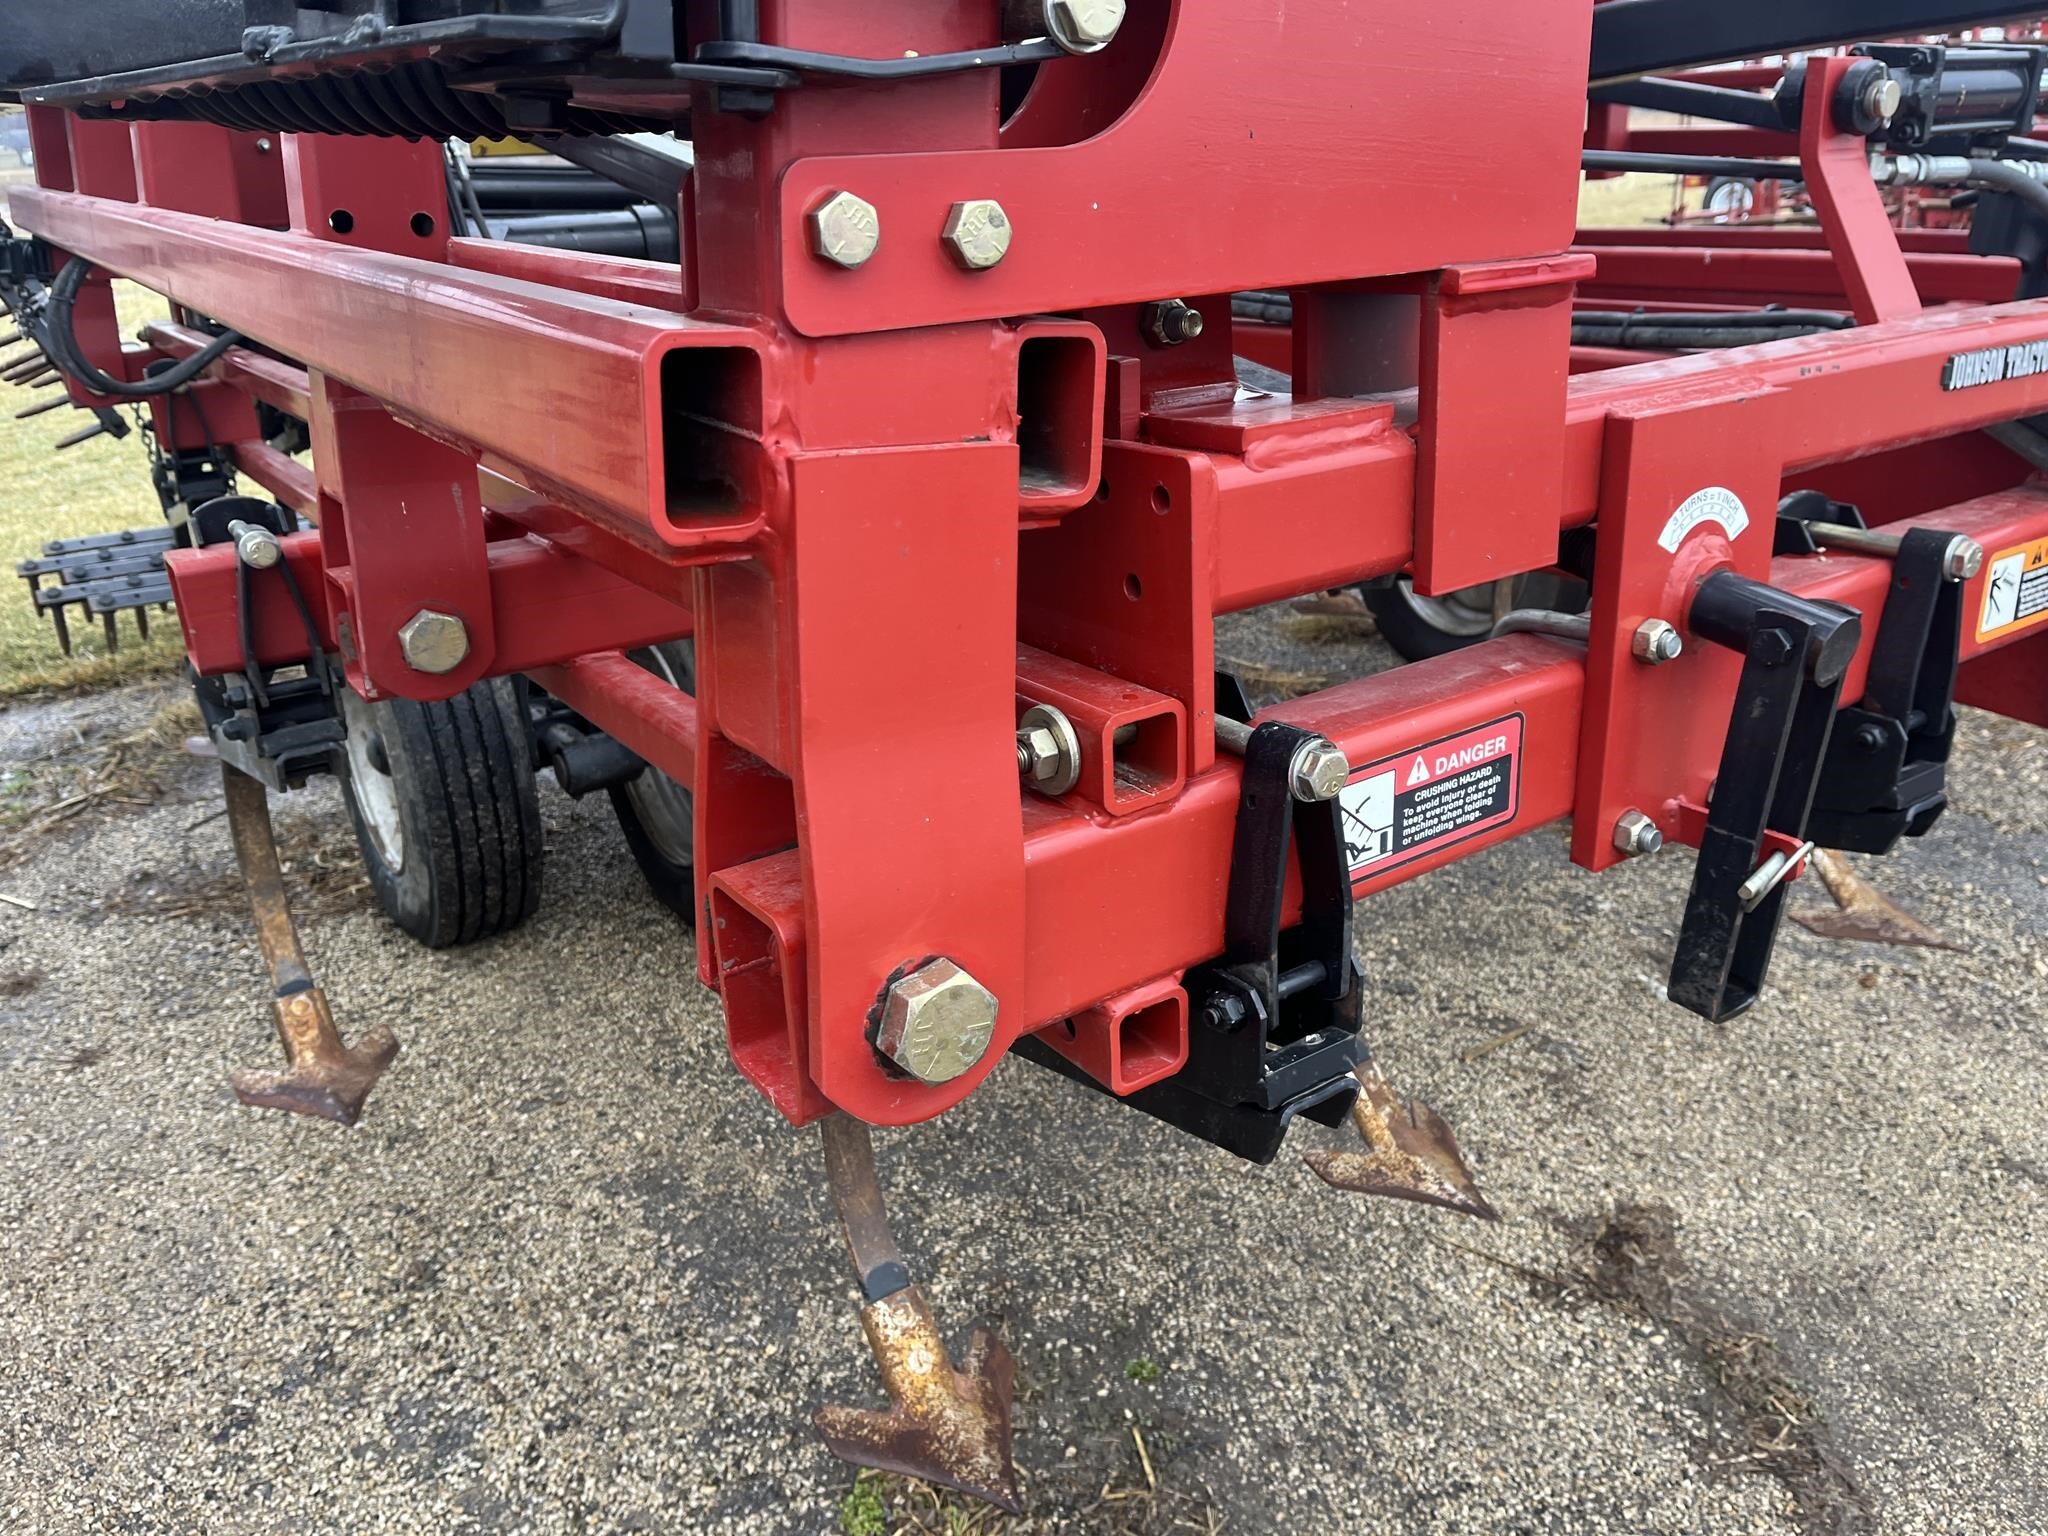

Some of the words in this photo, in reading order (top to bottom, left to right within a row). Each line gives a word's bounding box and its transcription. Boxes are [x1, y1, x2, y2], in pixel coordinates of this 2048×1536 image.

[1948, 348, 2007, 390] JOHNSON
[1679, 491, 1709, 517] TURNS
[1722, 492, 1740, 515] INCH
[1435, 736, 1507, 775] DANGER
[1403, 807, 1415, 818] To
[1416, 797, 1440, 813] avoid
[1442, 789, 1466, 808] injury
[1467, 785, 1477, 794] or
[1478, 773, 1502, 791] death
[1414, 778, 1458, 802] CRUSHING
[1459, 765, 1493, 787] HAZARD
[1402, 818, 1439, 837] machine
[1440, 808, 1463, 823] when
[1464, 796, 1493, 814] folding
[1403, 813, 1424, 828] keep
[1425, 799, 1464, 820] everyone
[1465, 789, 1487, 806] clear
[1487, 784, 1497, 795] of
[1402, 836, 1412, 846] or
[1414, 817, 1453, 840] unfolding
[1455, 810, 1483, 826] wings.
